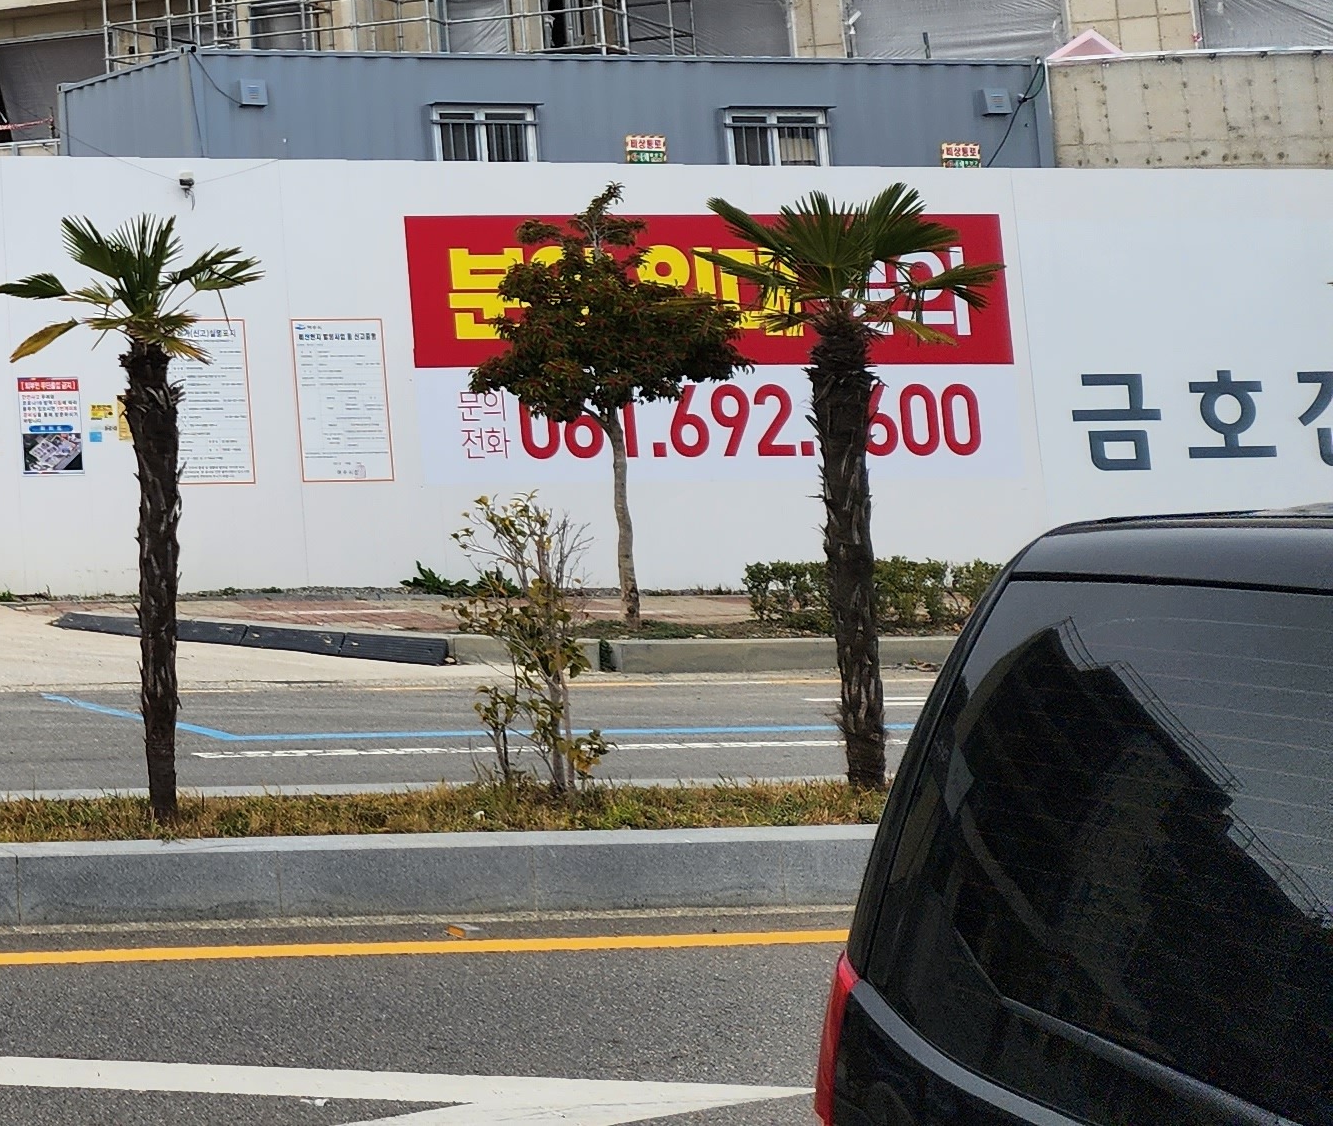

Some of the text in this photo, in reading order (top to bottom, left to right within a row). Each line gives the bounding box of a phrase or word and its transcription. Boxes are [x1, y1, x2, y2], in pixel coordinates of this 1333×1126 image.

[449, 245, 616, 340] 분
[457, 389, 507, 422] 문의
[518, 383, 982, 460] 061.692.600
[461, 427, 511, 460] 전화
